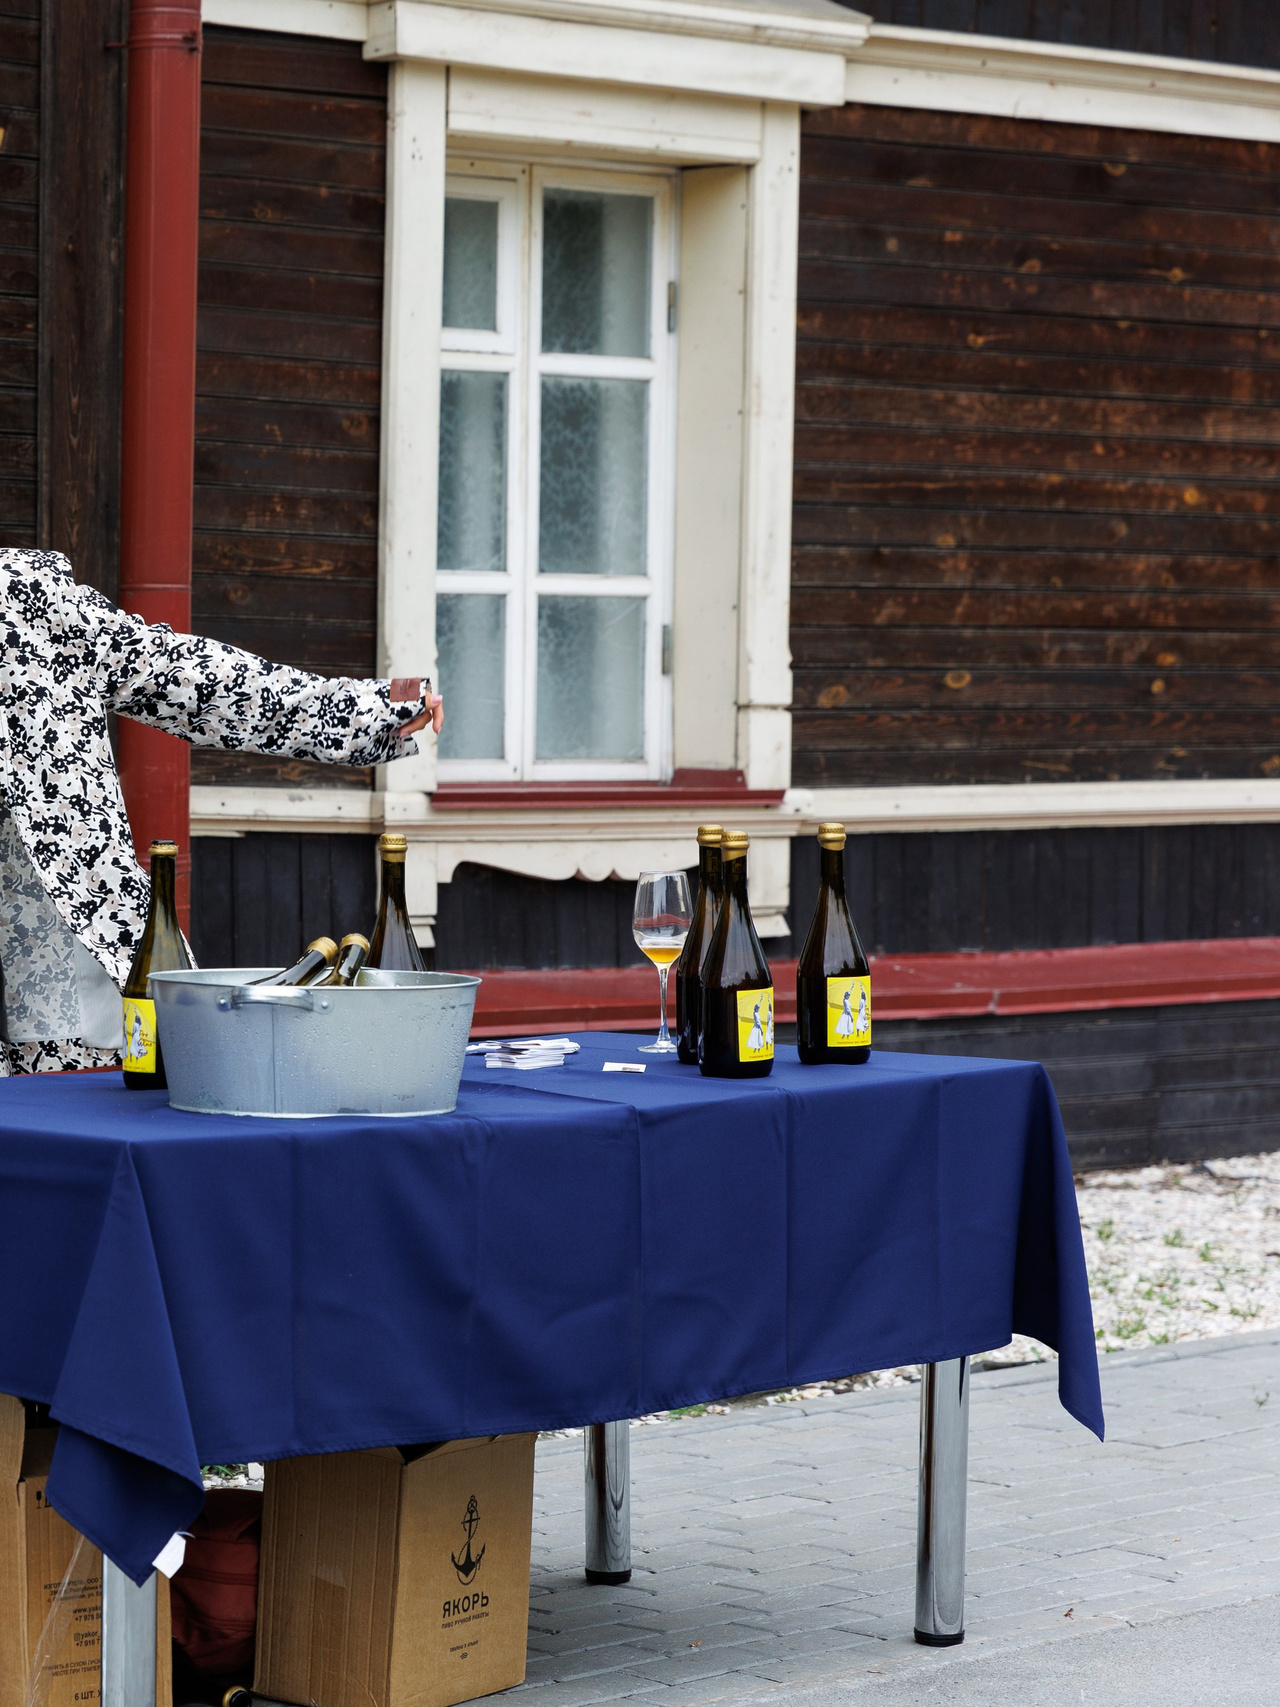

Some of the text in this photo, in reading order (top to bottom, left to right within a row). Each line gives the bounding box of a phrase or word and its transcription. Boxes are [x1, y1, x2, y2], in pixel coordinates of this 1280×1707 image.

[443, 1591, 489, 1618] ЯКОРЬ
[74, 1692, 80, 1701] 6
[81, 1690, 96, 1700] ШТ.
